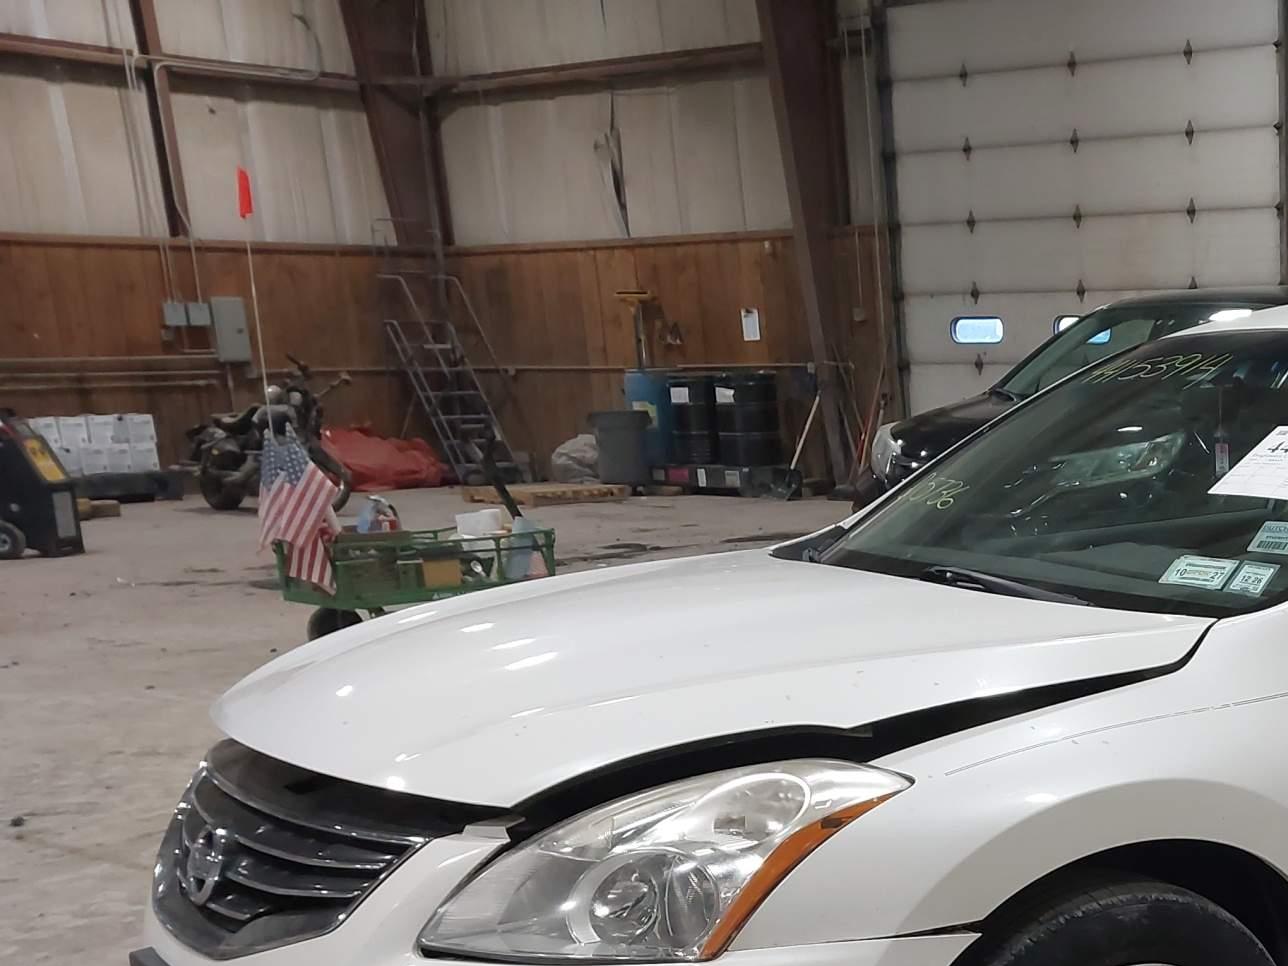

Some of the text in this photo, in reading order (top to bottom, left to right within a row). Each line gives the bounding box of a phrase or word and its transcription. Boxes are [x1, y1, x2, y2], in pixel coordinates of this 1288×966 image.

[1175, 568, 1188, 577] 10
[1209, 571, 1225, 580] 27
[1240, 575, 1252, 583] 12
